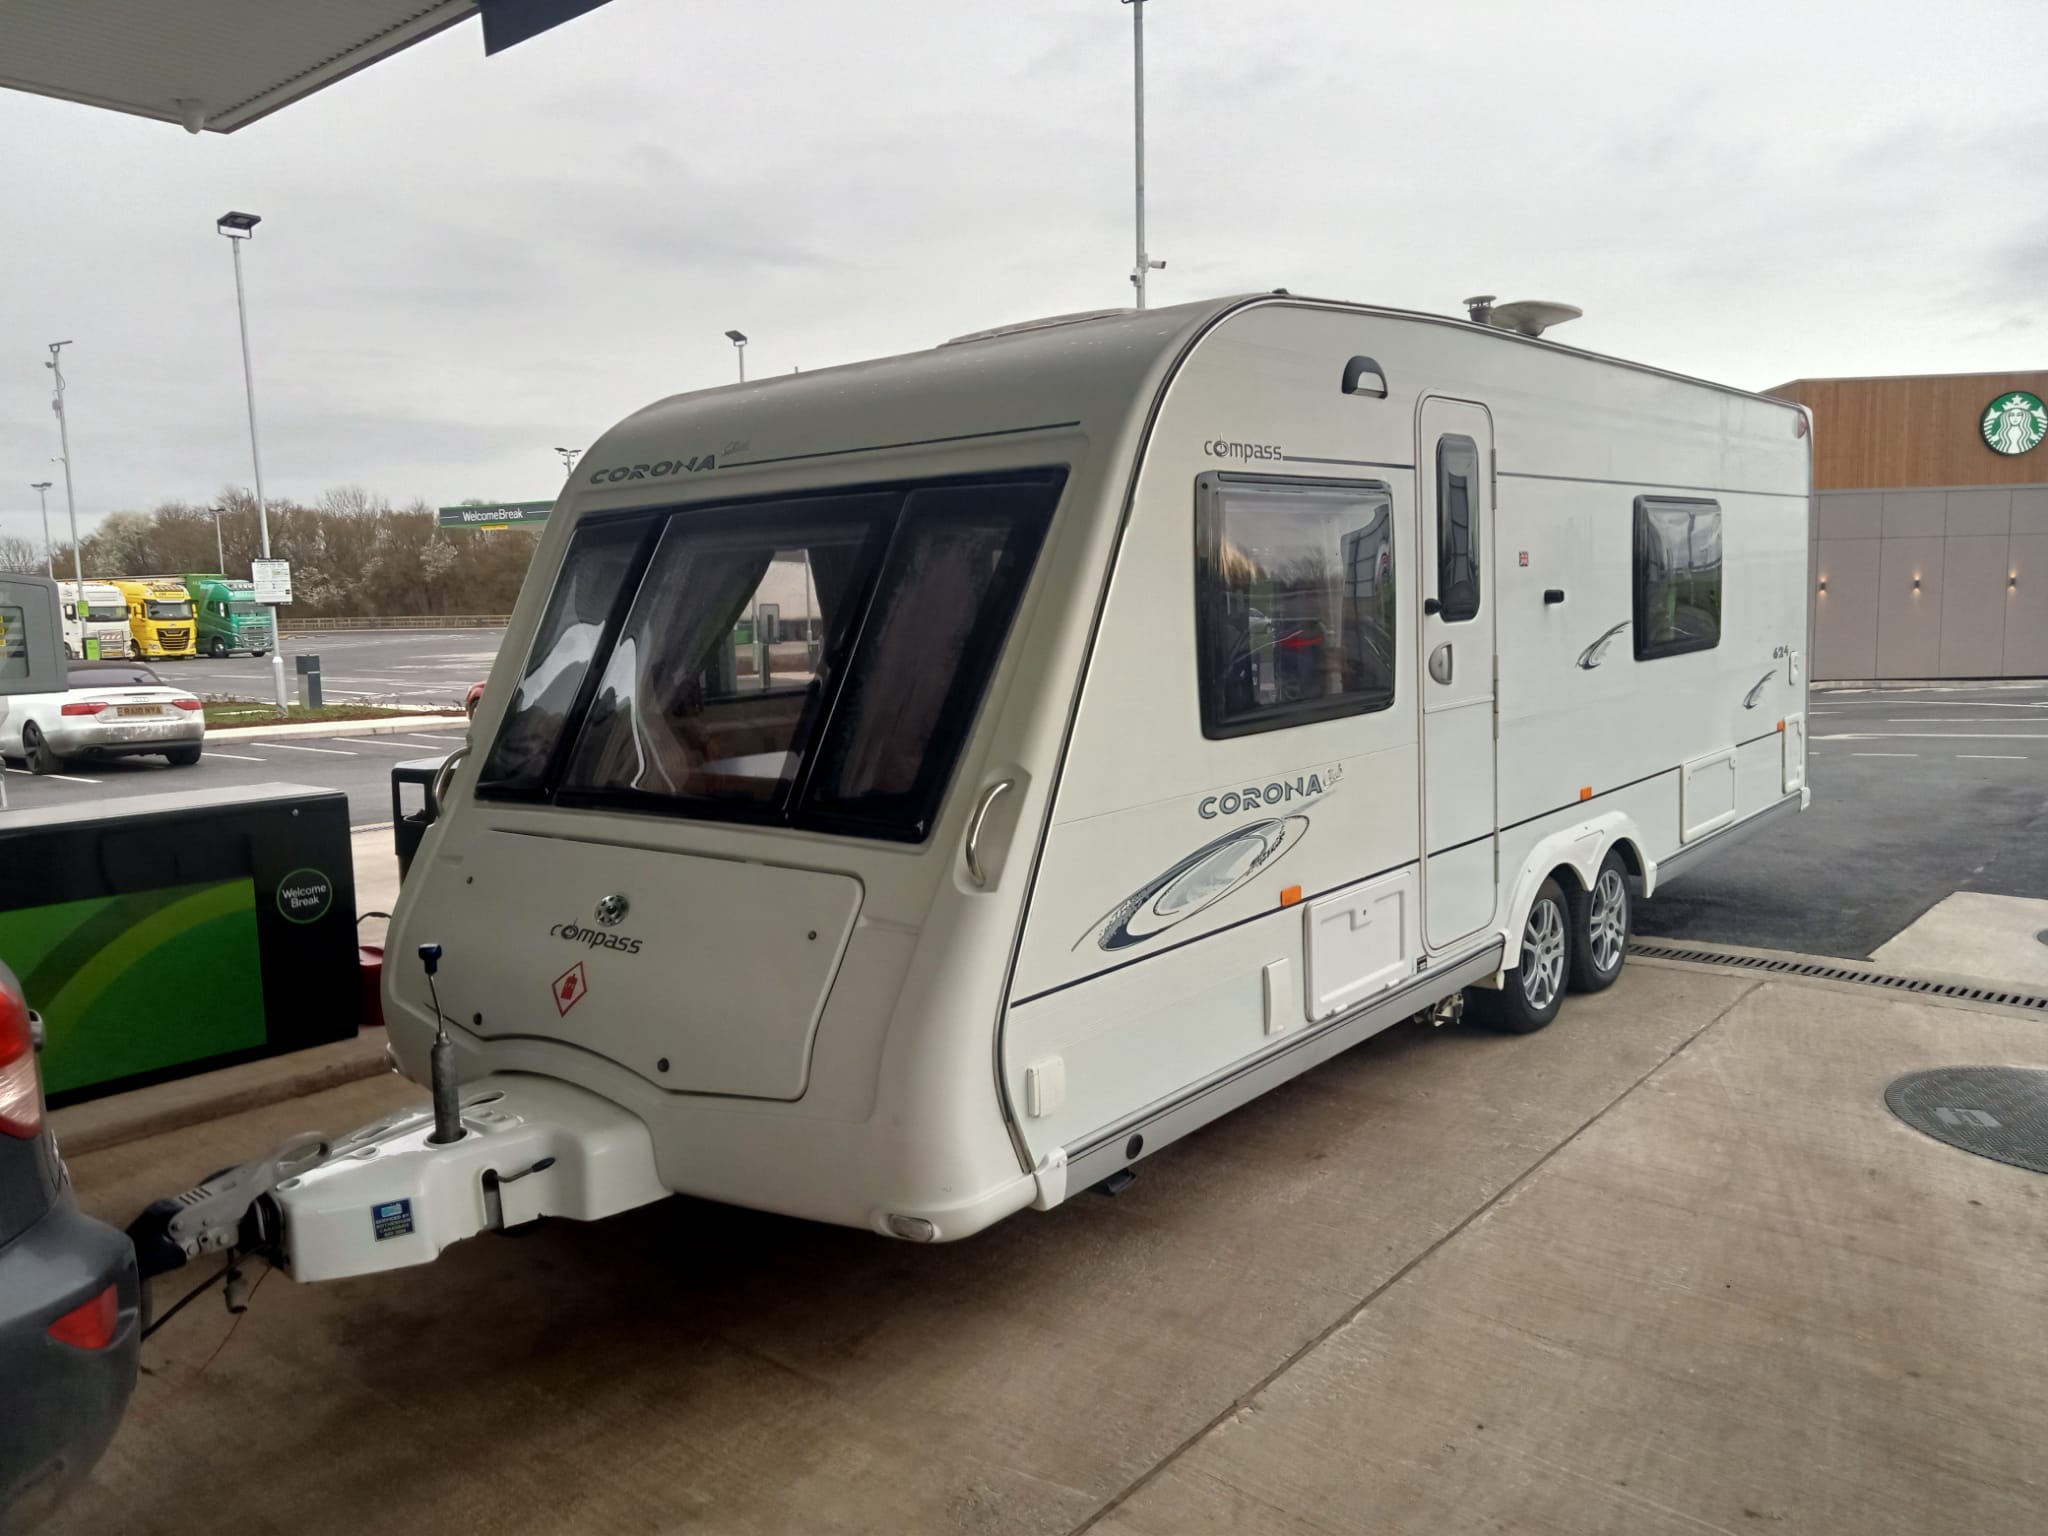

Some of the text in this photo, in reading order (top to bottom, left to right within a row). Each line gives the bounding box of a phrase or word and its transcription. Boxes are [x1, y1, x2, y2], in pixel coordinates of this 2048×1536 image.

[1204, 436, 1281, 463] compass
[590, 454, 715, 484] CORONA
[1198, 774, 1322, 820] CORONA
[282, 885, 326, 899] Welcome
[290, 896, 319, 908] Break
[550, 919, 643, 954] compass
